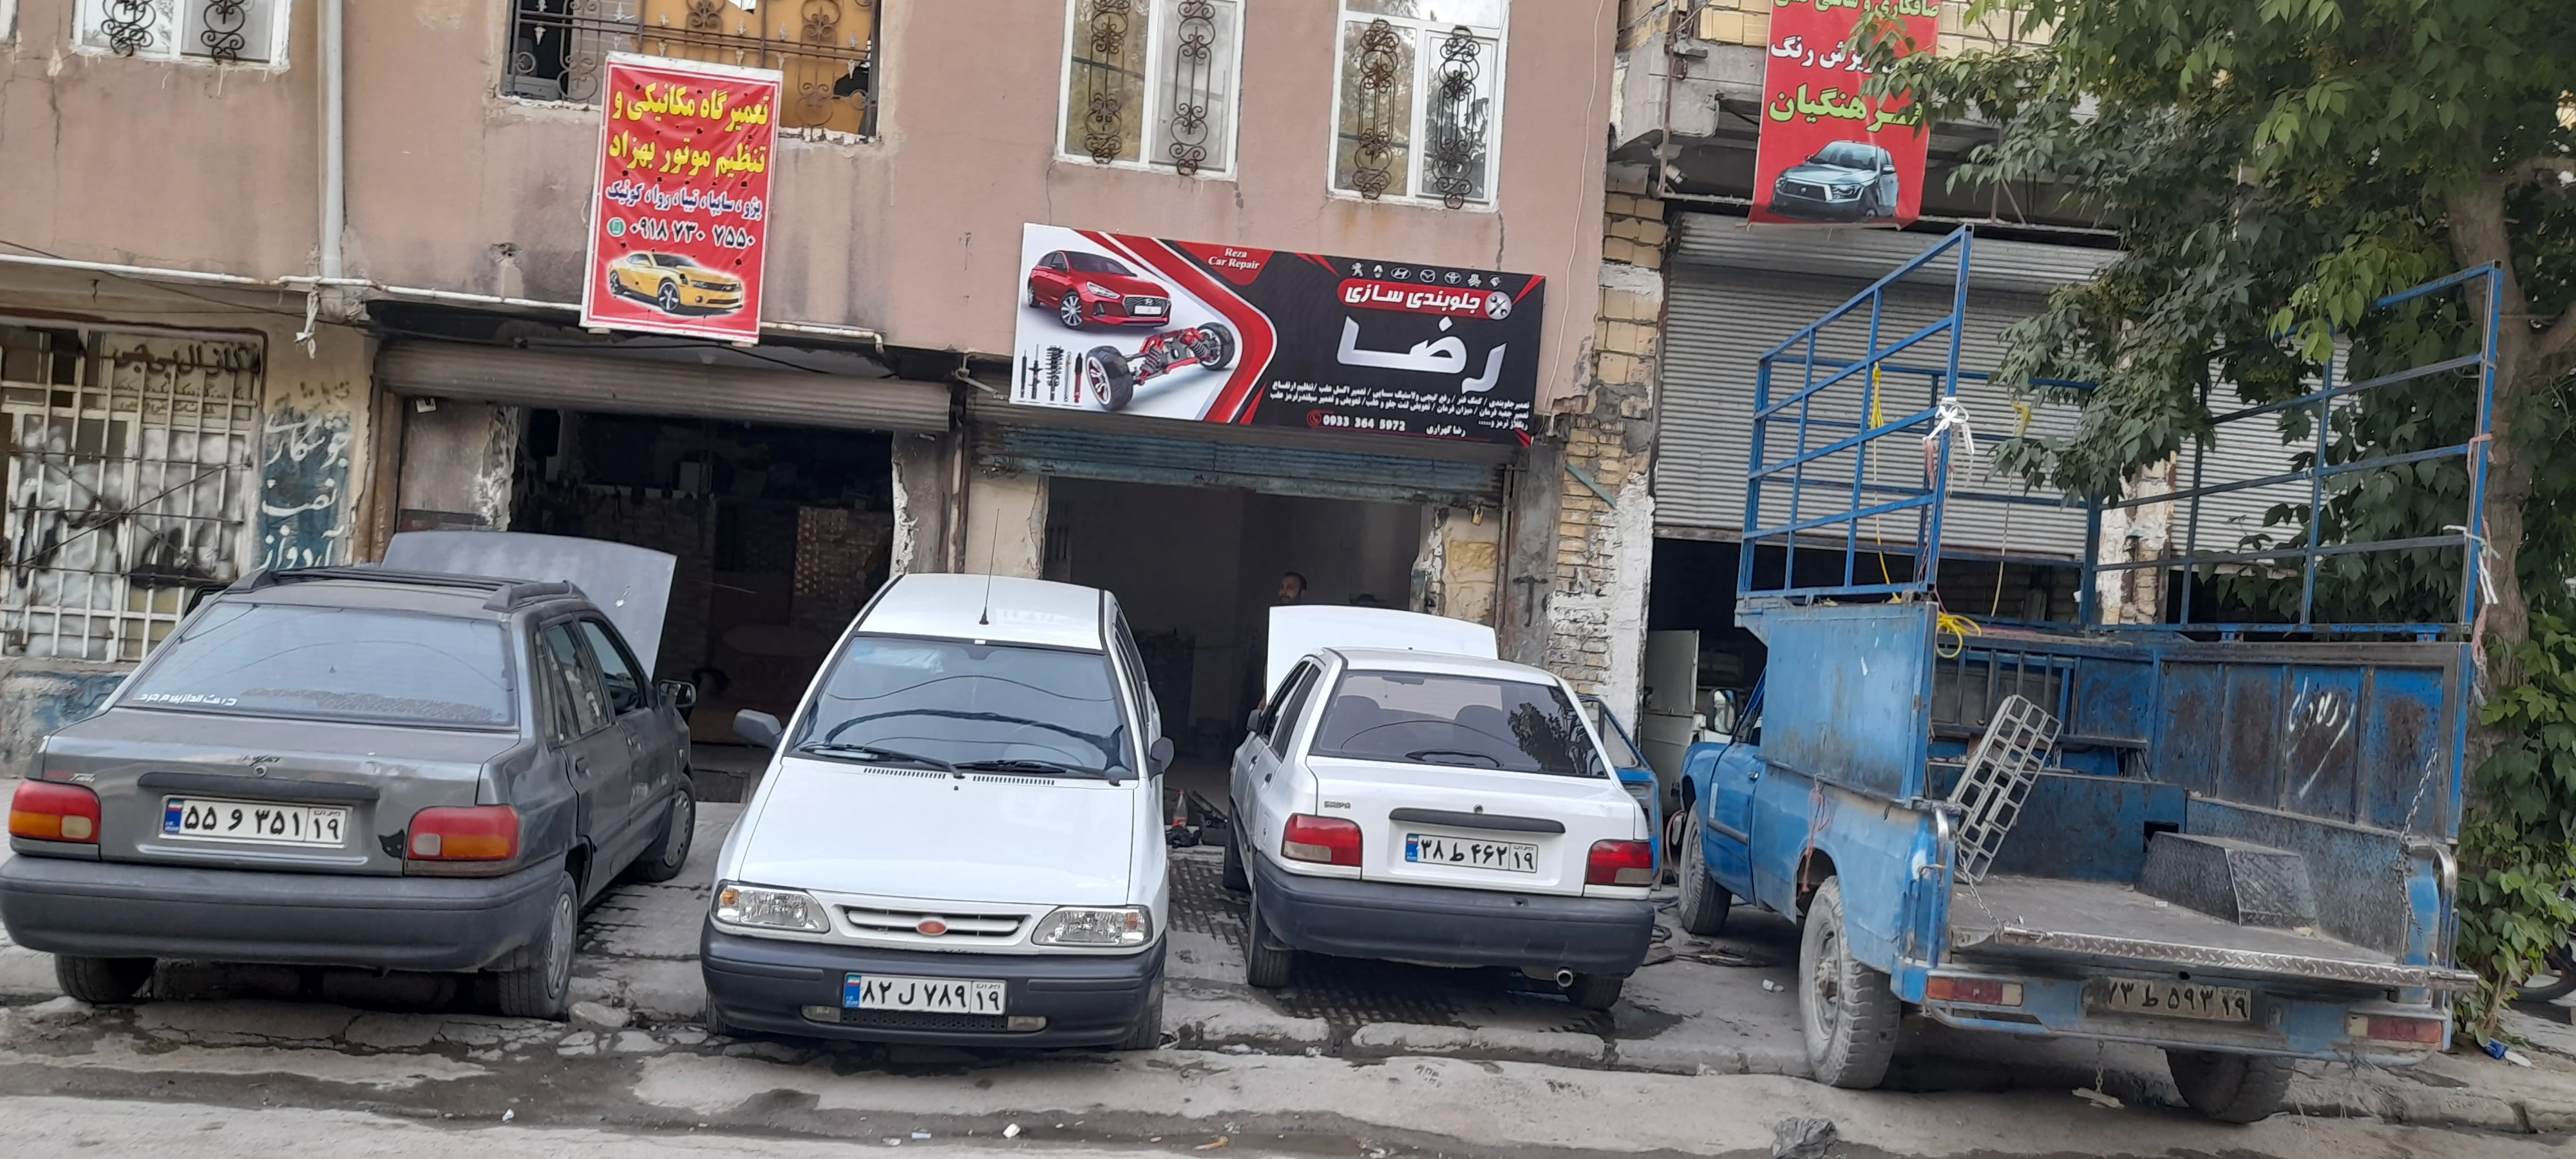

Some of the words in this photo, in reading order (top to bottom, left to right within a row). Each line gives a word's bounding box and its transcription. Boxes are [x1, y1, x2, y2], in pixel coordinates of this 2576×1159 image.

[1770, 35, 1815, 67] رنگ
[611, 90, 625, 120] و
[626, 82, 696, 122] مکانیکی
[724, 95, 771, 133] تعمیر
[608, 129, 656, 171] بهزاد
[658, 137, 711, 176] موتور
[715, 141, 767, 178] تنظیم
[630, 218, 668, 241] ۰۹۱۸
[672, 221, 706, 244] ۷۳۰
[712, 225, 755, 250] ۷۵۵۰
[1208, 256, 1227, 267] Car
[1228, 258, 1260, 270] Repair
[1224, 248, 1248, 258] Reza
[1345, 284, 1405, 303] سازی
[1406, 290, 1481, 314] جلوبندی
[1336, 316, 1508, 395] رضا
[1323, 415, 1349, 427] 0933
[1354, 417, 1375, 429] 364
[1379, 419, 1406, 431] 5972
[184, 805, 218, 831] ۵۵
[256, 808, 299, 836] ۳۵۱
[314, 817, 340, 840] ۱۹
[1421, 839, 1444, 860] ۳۸
[1471, 843, 1507, 866] ۴۶۲
[1513, 851, 1534, 870] ۱۹
[862, 980, 893, 1005] ۸۲
[923, 983, 967, 1008] ۷۸۹
[976, 991, 1000, 1012] ۱۹
